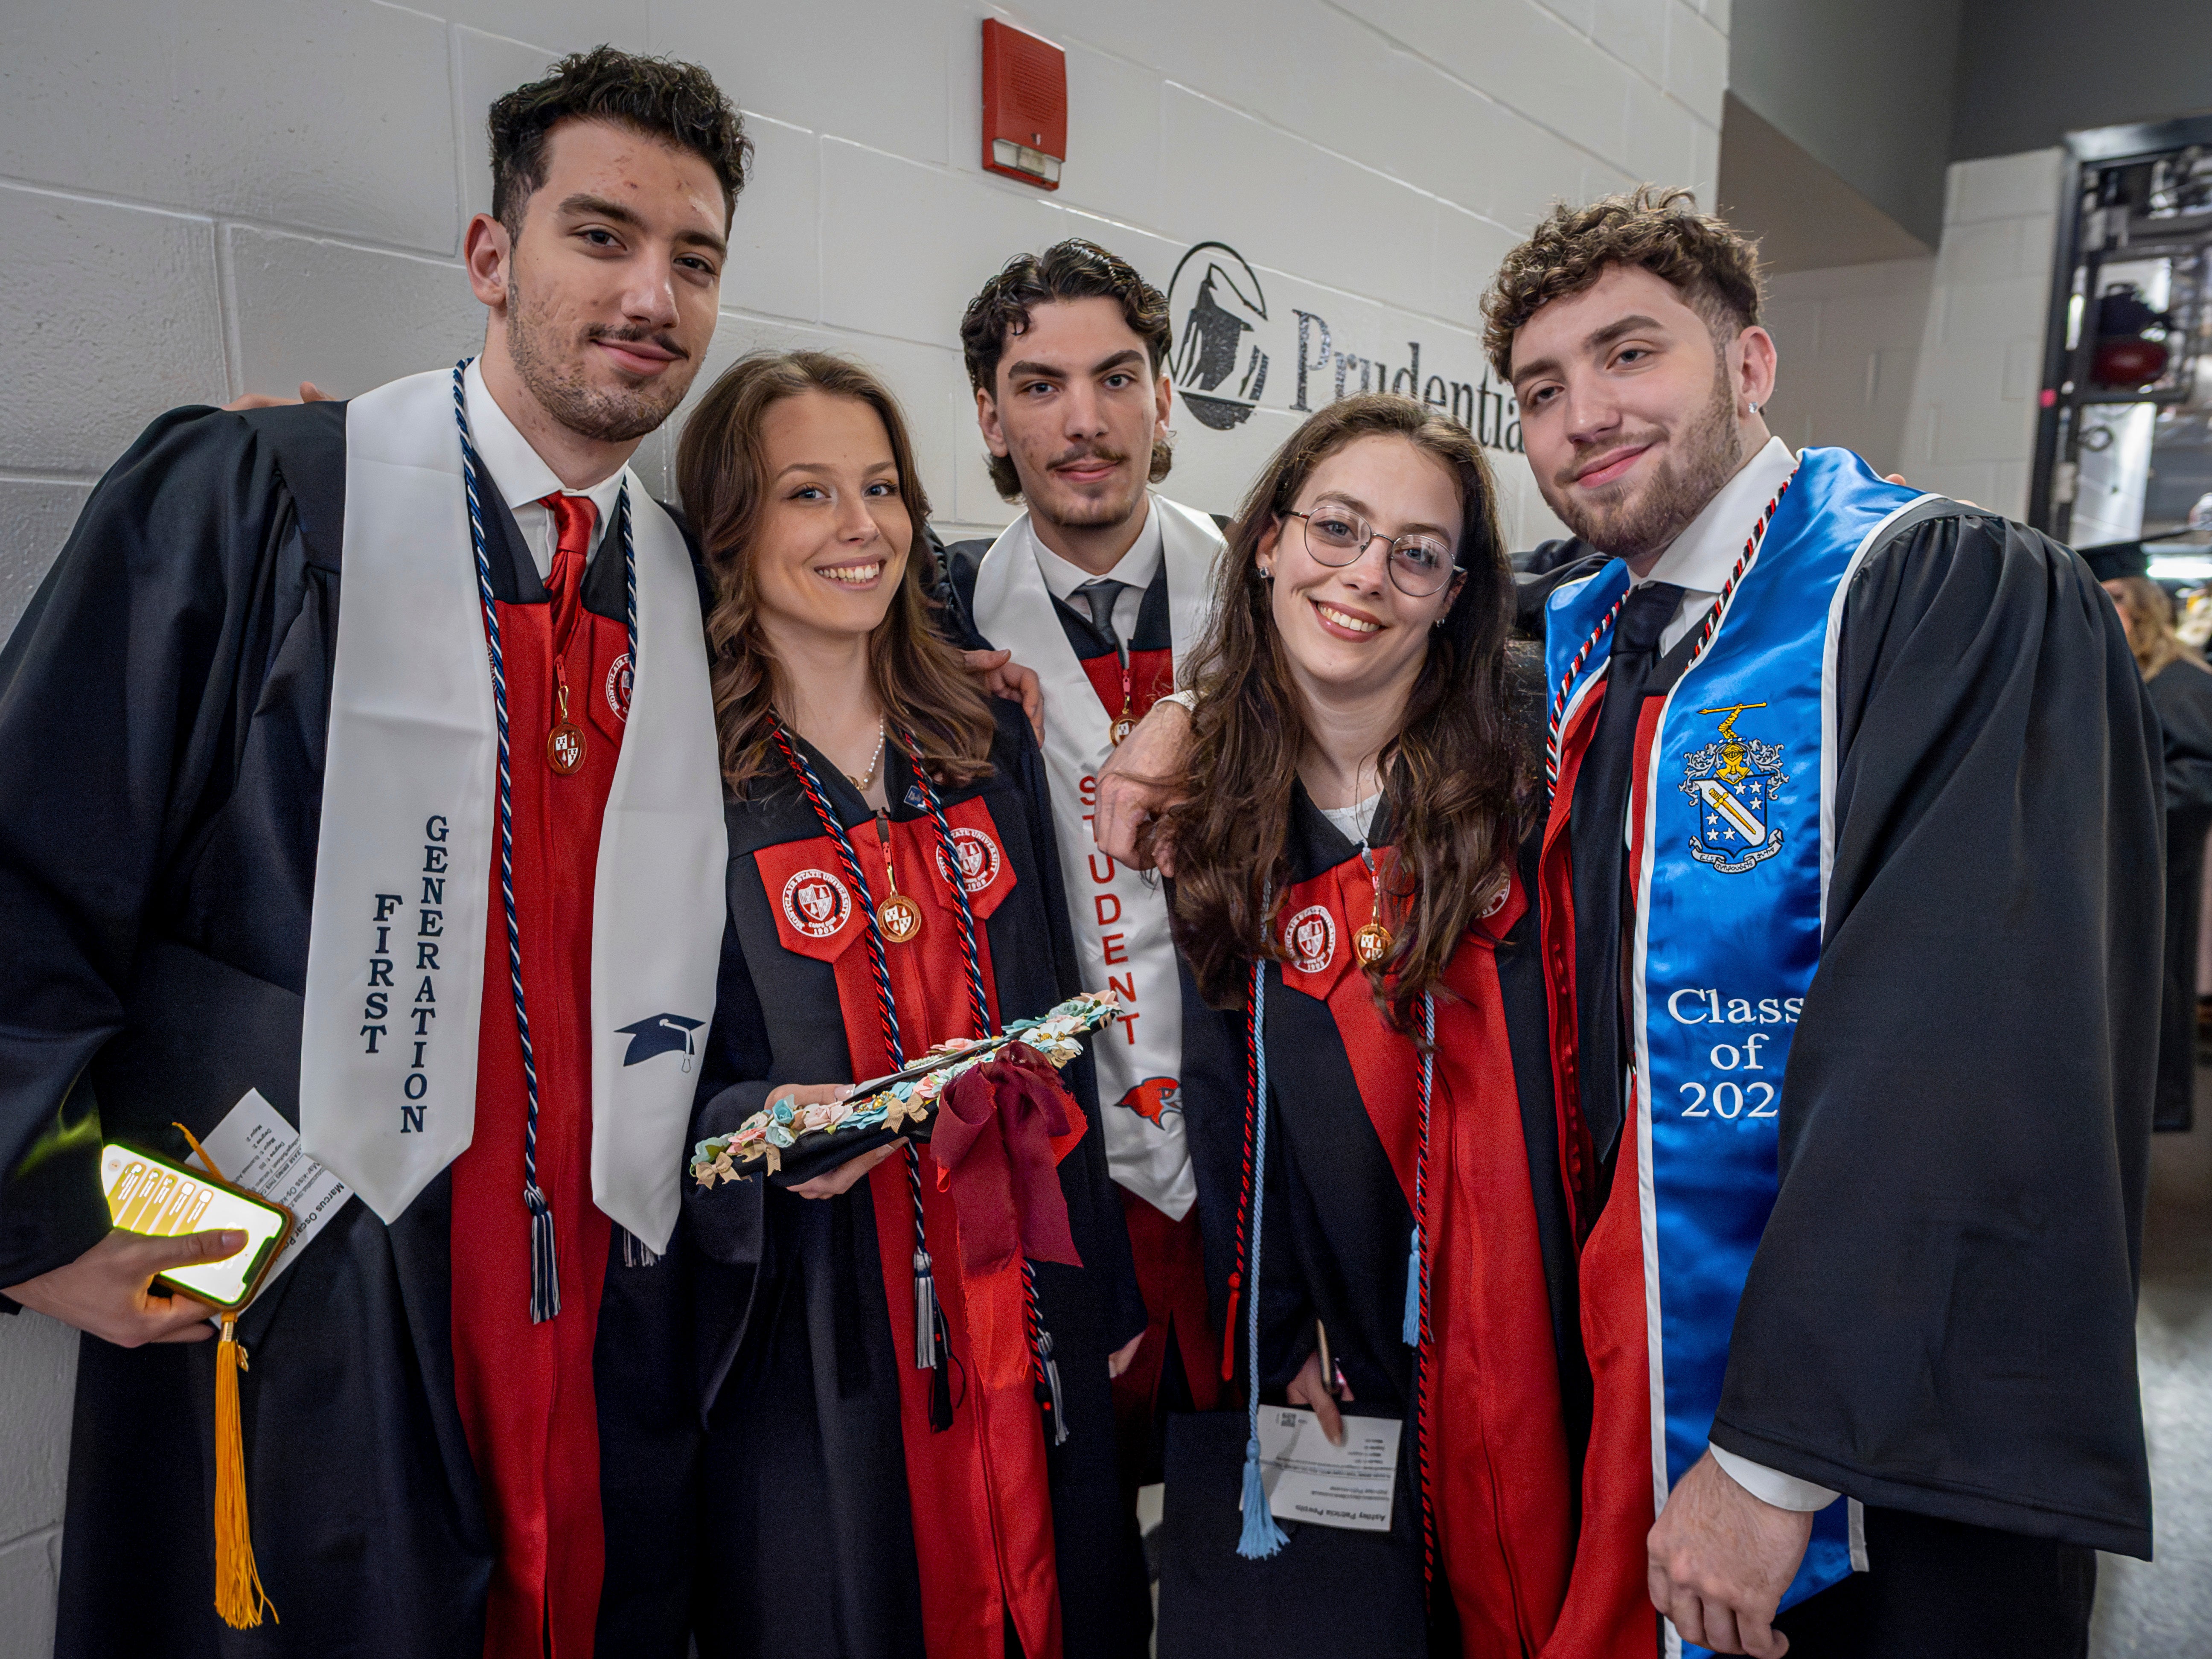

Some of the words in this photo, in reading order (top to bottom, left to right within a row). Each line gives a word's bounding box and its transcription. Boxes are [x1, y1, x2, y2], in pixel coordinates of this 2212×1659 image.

[1289, 309, 1526, 454] Prudentia
[785, 879, 805, 930] MONTCLAIR
[796, 871, 822, 884] STATE
[823, 873, 849, 919] UNIVERSITY
[360, 894, 403, 1054] FIRST
[400, 815, 449, 1133] GENERATION
[1668, 988, 1805, 1025] Class
[1710, 1033, 1770, 1070] of
[1679, 1082, 1778, 1119] 202
[316, 1182, 344, 1212] Marcus
[292, 1213, 317, 1237] Oscar
